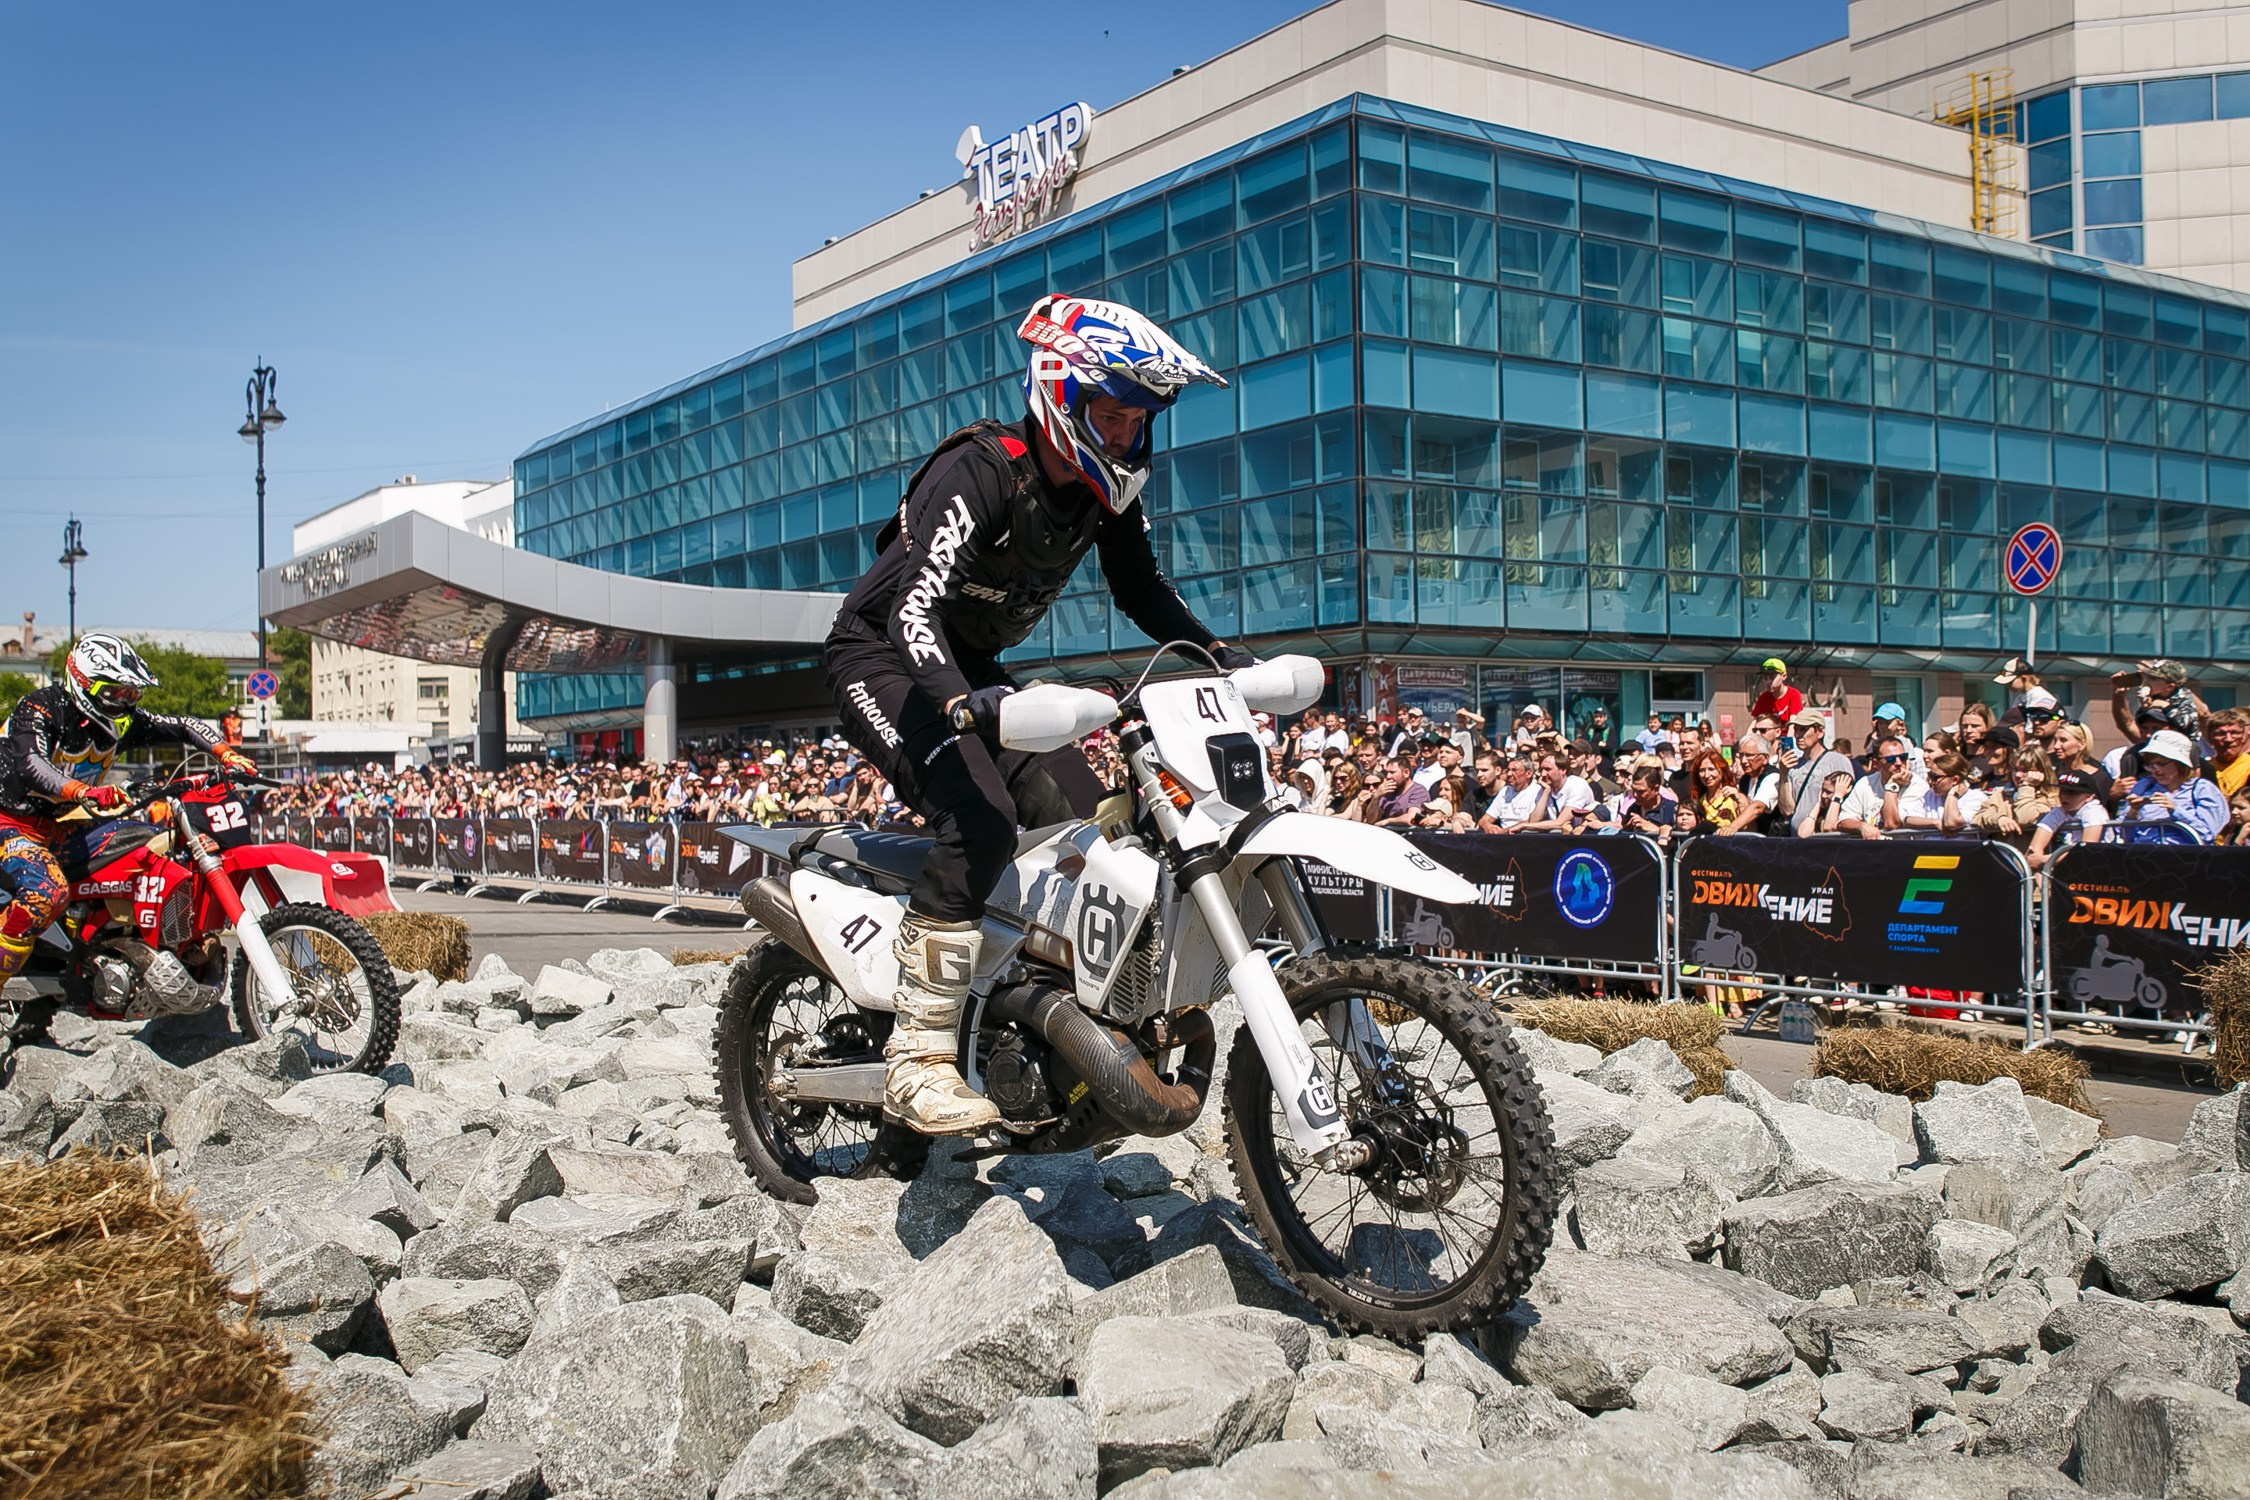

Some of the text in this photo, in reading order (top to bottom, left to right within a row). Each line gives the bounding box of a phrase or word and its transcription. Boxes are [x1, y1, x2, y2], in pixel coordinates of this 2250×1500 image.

[970, 101, 1091, 205] ТЕАТР
[1195, 687, 1228, 723] 47
[205, 801, 248, 833] 32
[1496, 874, 1515, 882] УРАЛ
[1691, 869, 1733, 878] ФЕСТИВАЛЬ
[78, 880, 132, 896] GASGAS
[1307, 875, 1364, 888] КУЛЬТУРЫ
[2068, 882, 2131, 894] ФЕСТИВАЛЬ
[1811, 886, 1834, 896] УРАЛ
[840, 913, 882, 955] 47
[1887, 922, 1959, 935] ДЕПАРТАМЕНТ
[1887, 932, 1926, 943] СПОРТА
[1370, 988, 1397, 1003] EXCEL
